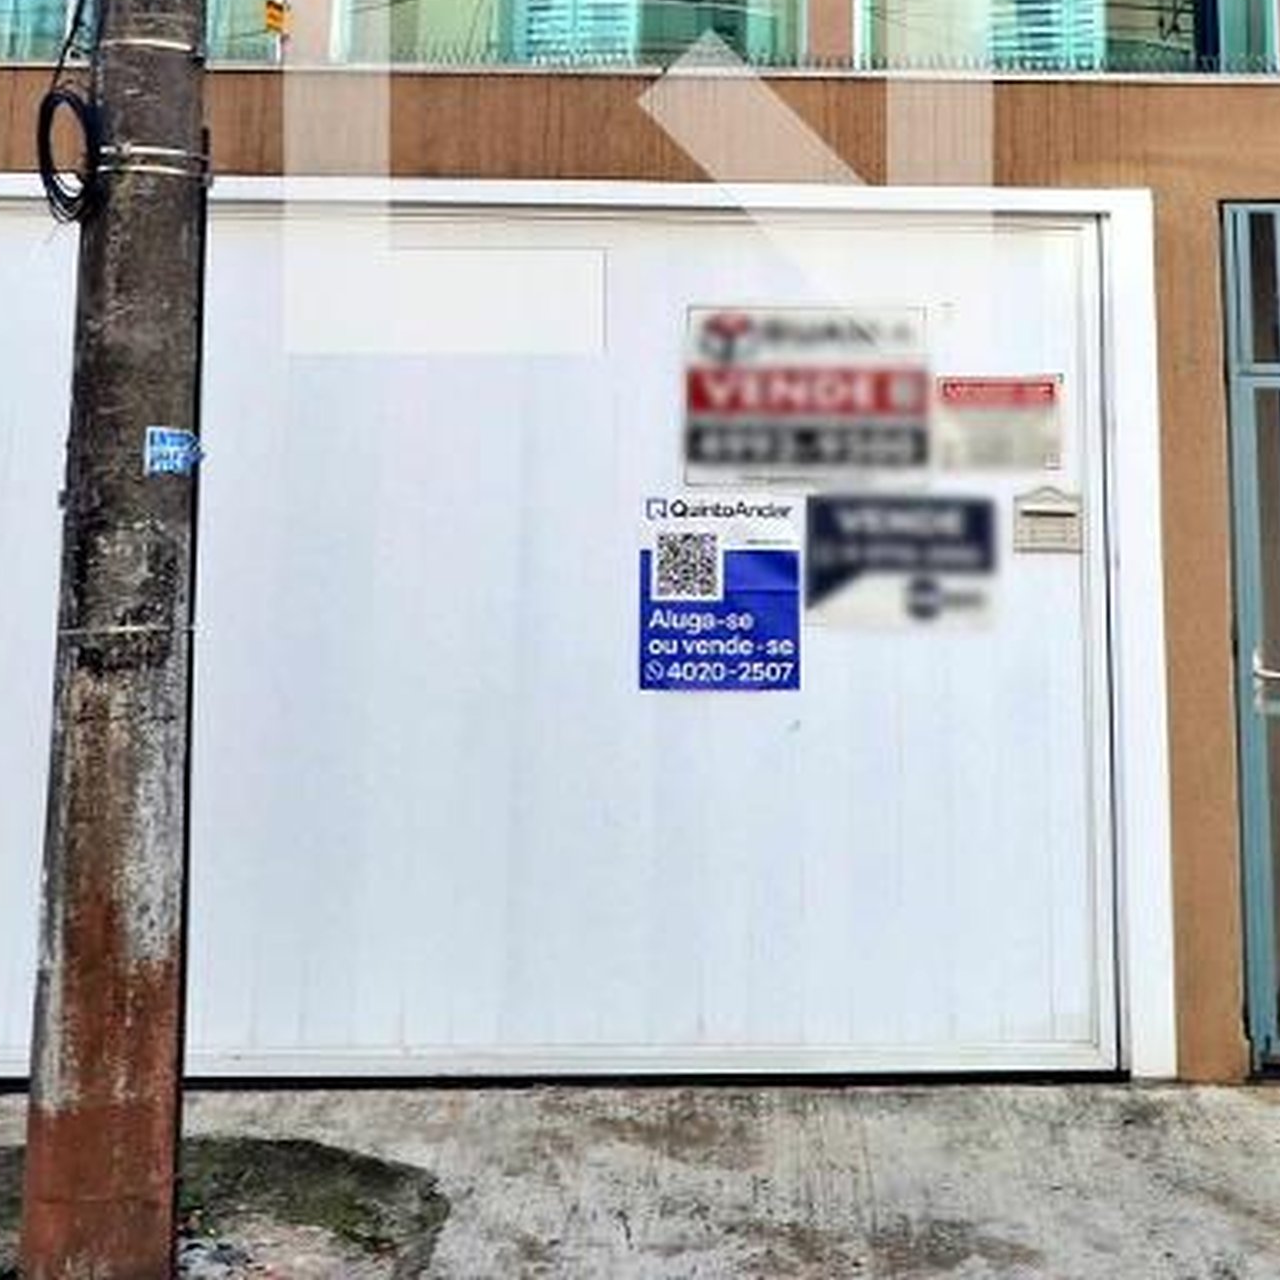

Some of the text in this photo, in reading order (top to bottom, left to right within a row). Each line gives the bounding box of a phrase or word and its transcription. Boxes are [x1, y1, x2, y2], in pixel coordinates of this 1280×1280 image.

[670, 499, 793, 518] QuintoAndar
[649, 608, 754, 635] Aluga-se
[649, 635, 795, 655] ou vende-se
[666, 662, 794, 682] 4020-2507
